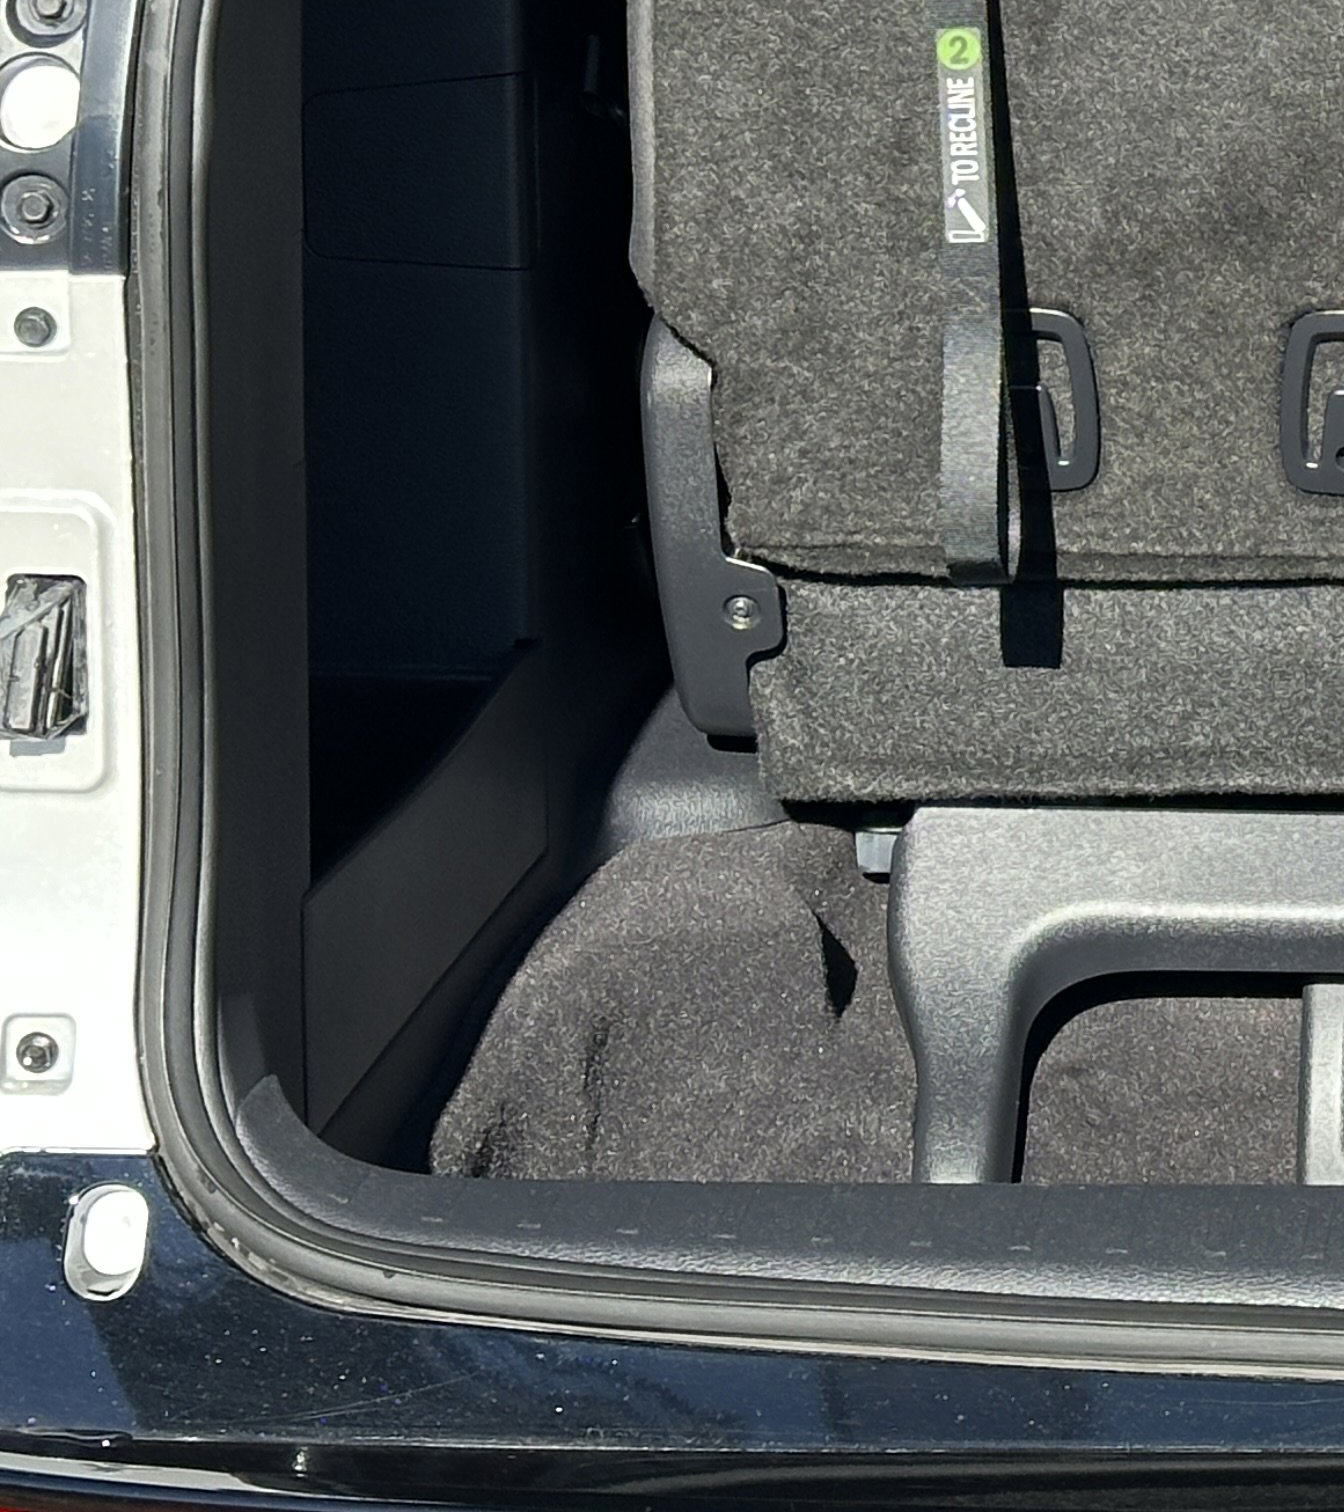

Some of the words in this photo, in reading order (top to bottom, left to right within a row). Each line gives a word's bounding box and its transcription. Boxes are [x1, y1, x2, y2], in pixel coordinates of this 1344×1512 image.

[948, 35, 969, 65] 2
[947, 76, 978, 157] RECLINE
[951, 158, 980, 185] TO
